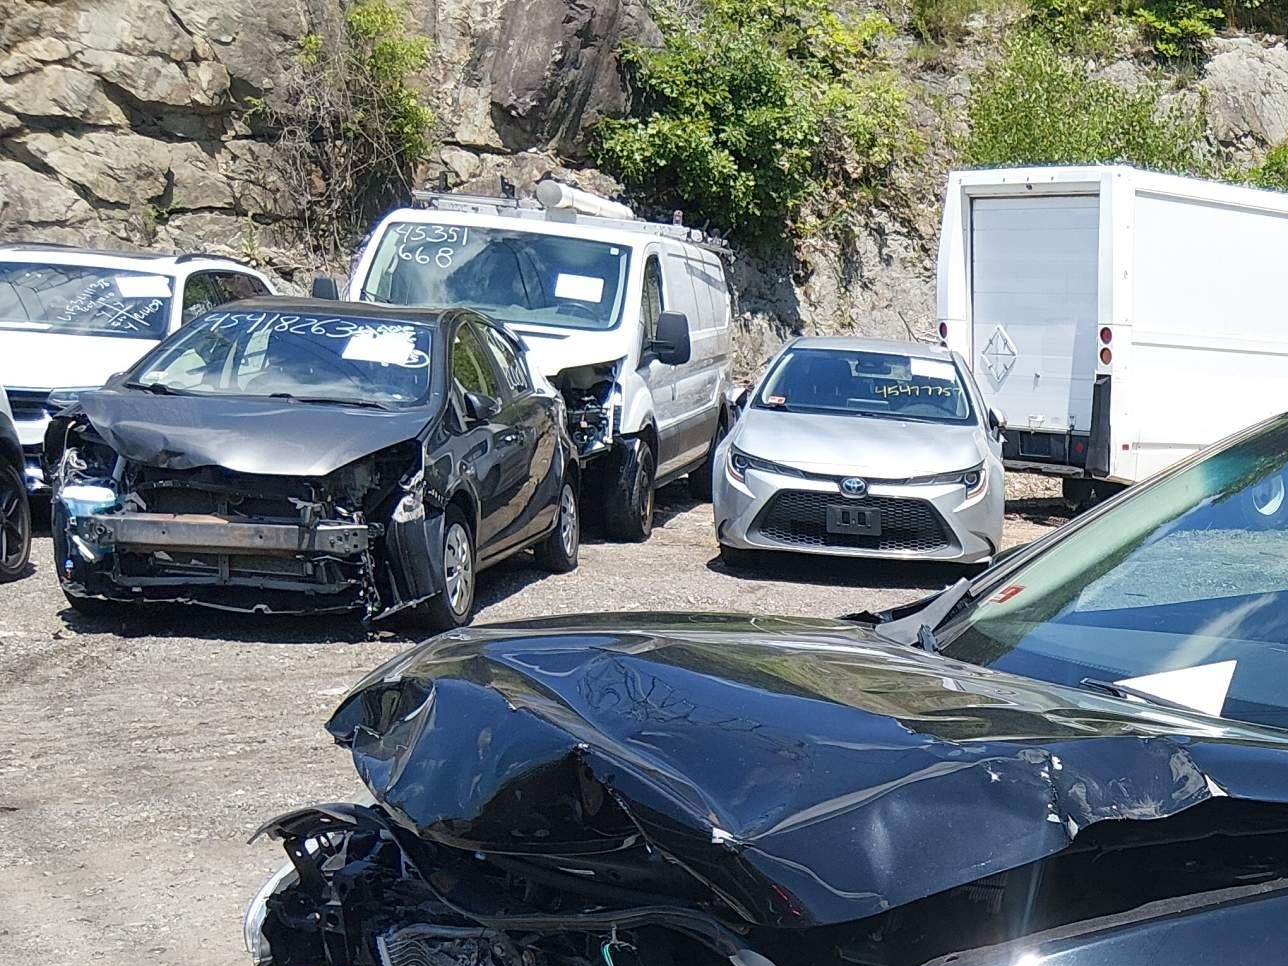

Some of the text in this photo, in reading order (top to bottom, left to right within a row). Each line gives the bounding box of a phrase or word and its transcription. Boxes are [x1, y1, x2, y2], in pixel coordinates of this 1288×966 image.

[396, 224, 470, 247] 45351
[398, 243, 455, 269] 668
[203, 311, 358, 338] 45418263
[874, 384, 964, 399] 45477757
